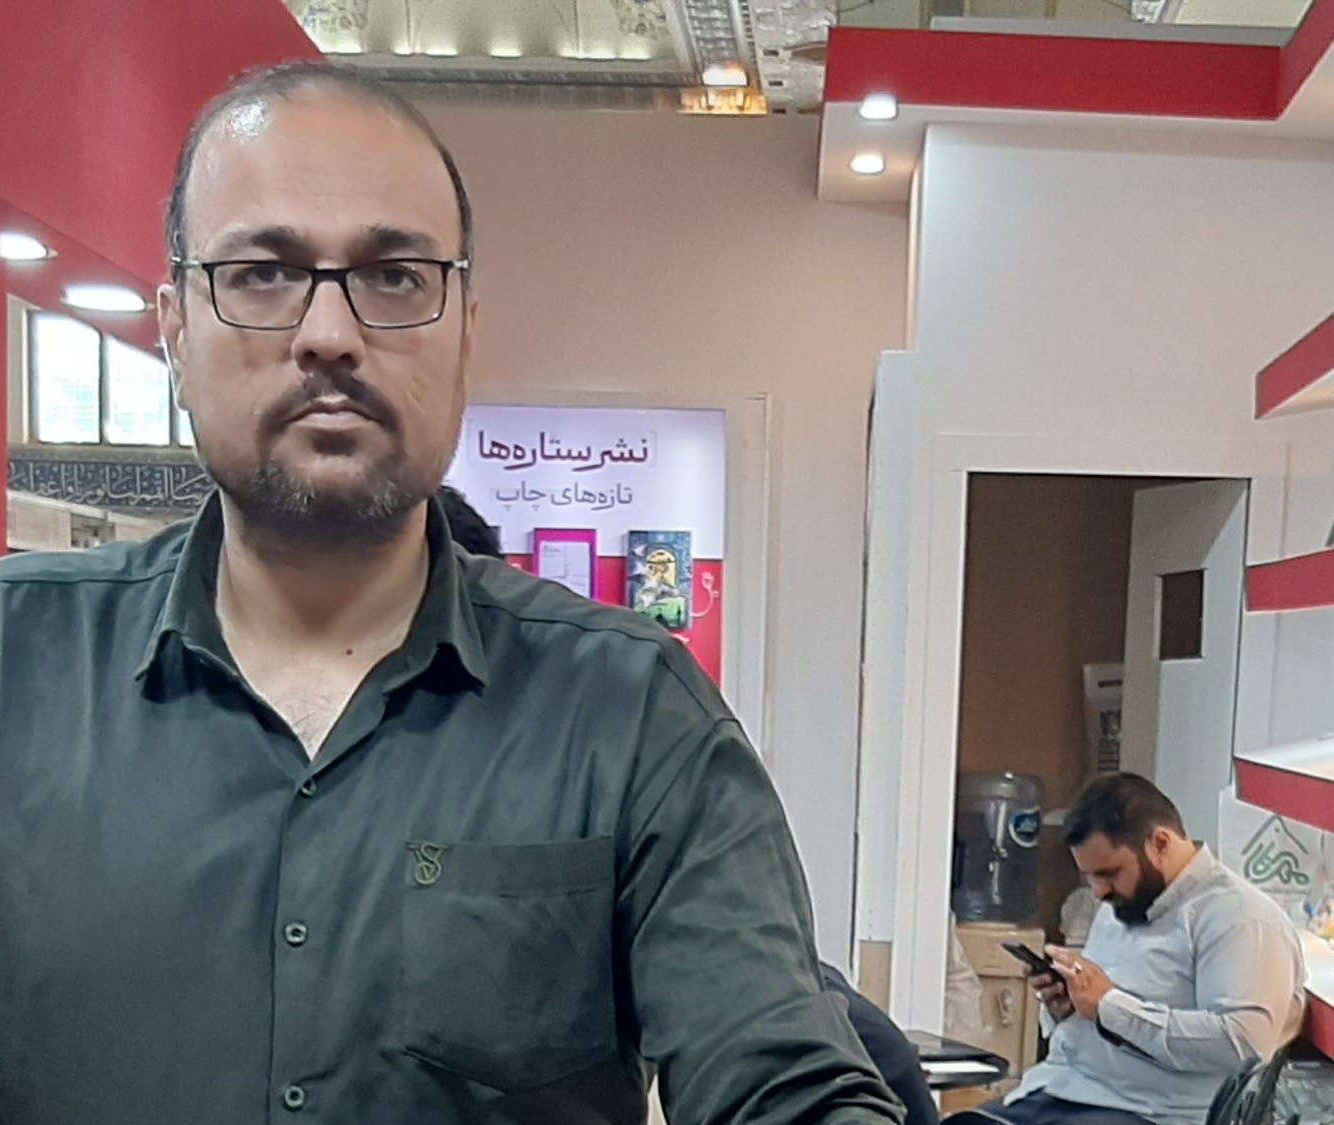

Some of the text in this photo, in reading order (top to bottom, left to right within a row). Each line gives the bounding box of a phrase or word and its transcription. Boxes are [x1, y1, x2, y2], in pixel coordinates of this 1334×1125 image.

[478, 430, 649, 471] نشر ستاره‌ها
[495, 480, 633, 511] تازه‌های چاپ
